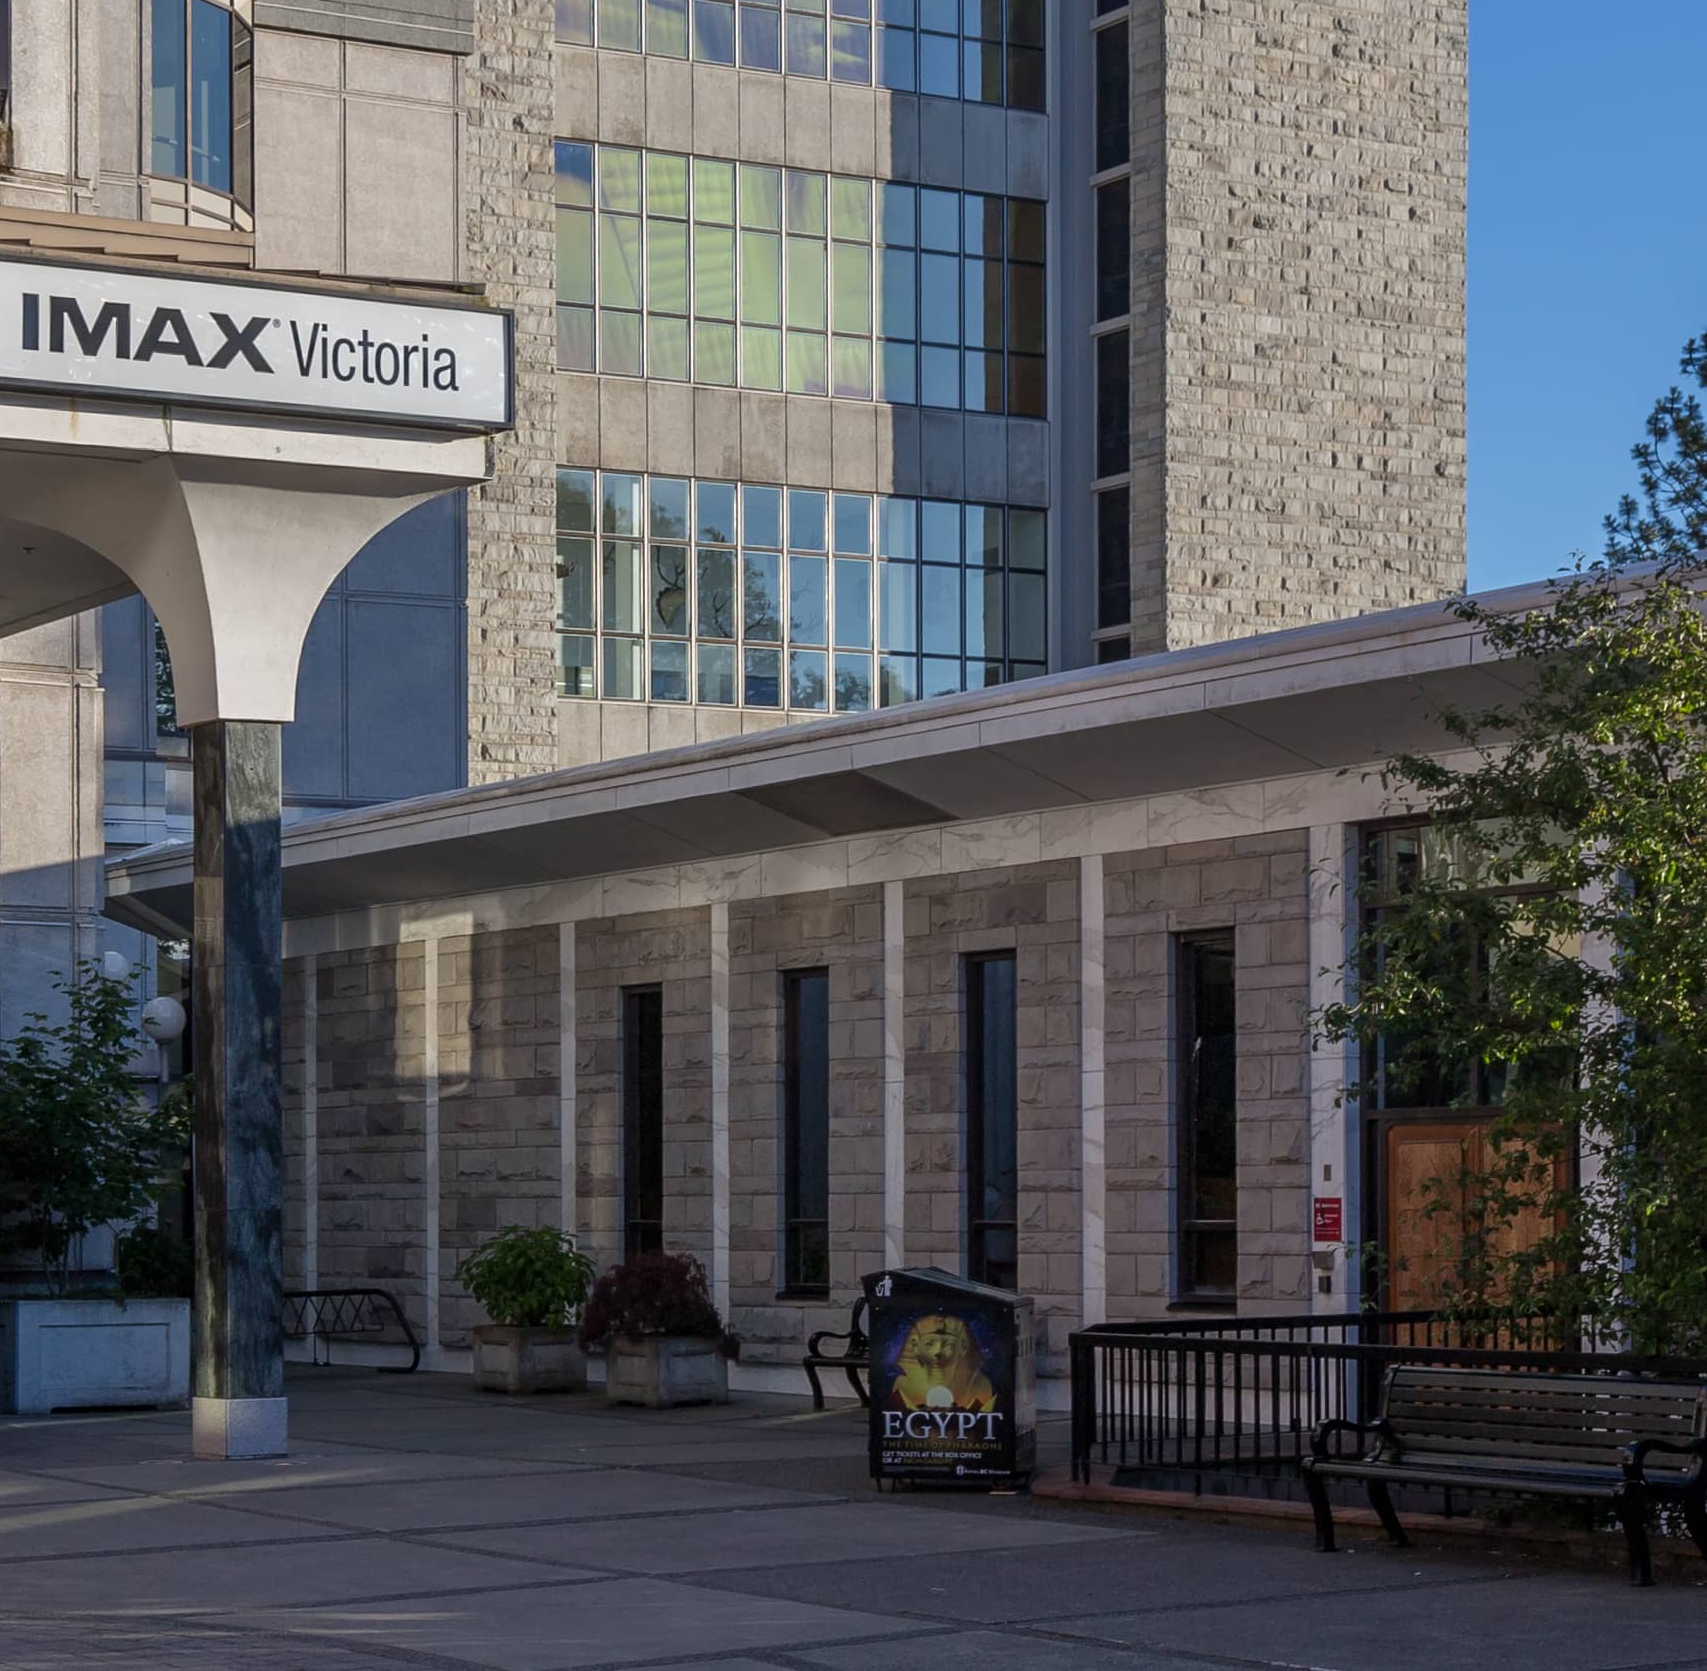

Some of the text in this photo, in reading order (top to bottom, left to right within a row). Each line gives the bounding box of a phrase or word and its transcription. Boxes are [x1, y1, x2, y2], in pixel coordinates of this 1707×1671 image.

[21, 291, 275, 375] IMAX
[291, 319, 459, 393] Victoria
[882, 1411, 1004, 1440] EGYPT
